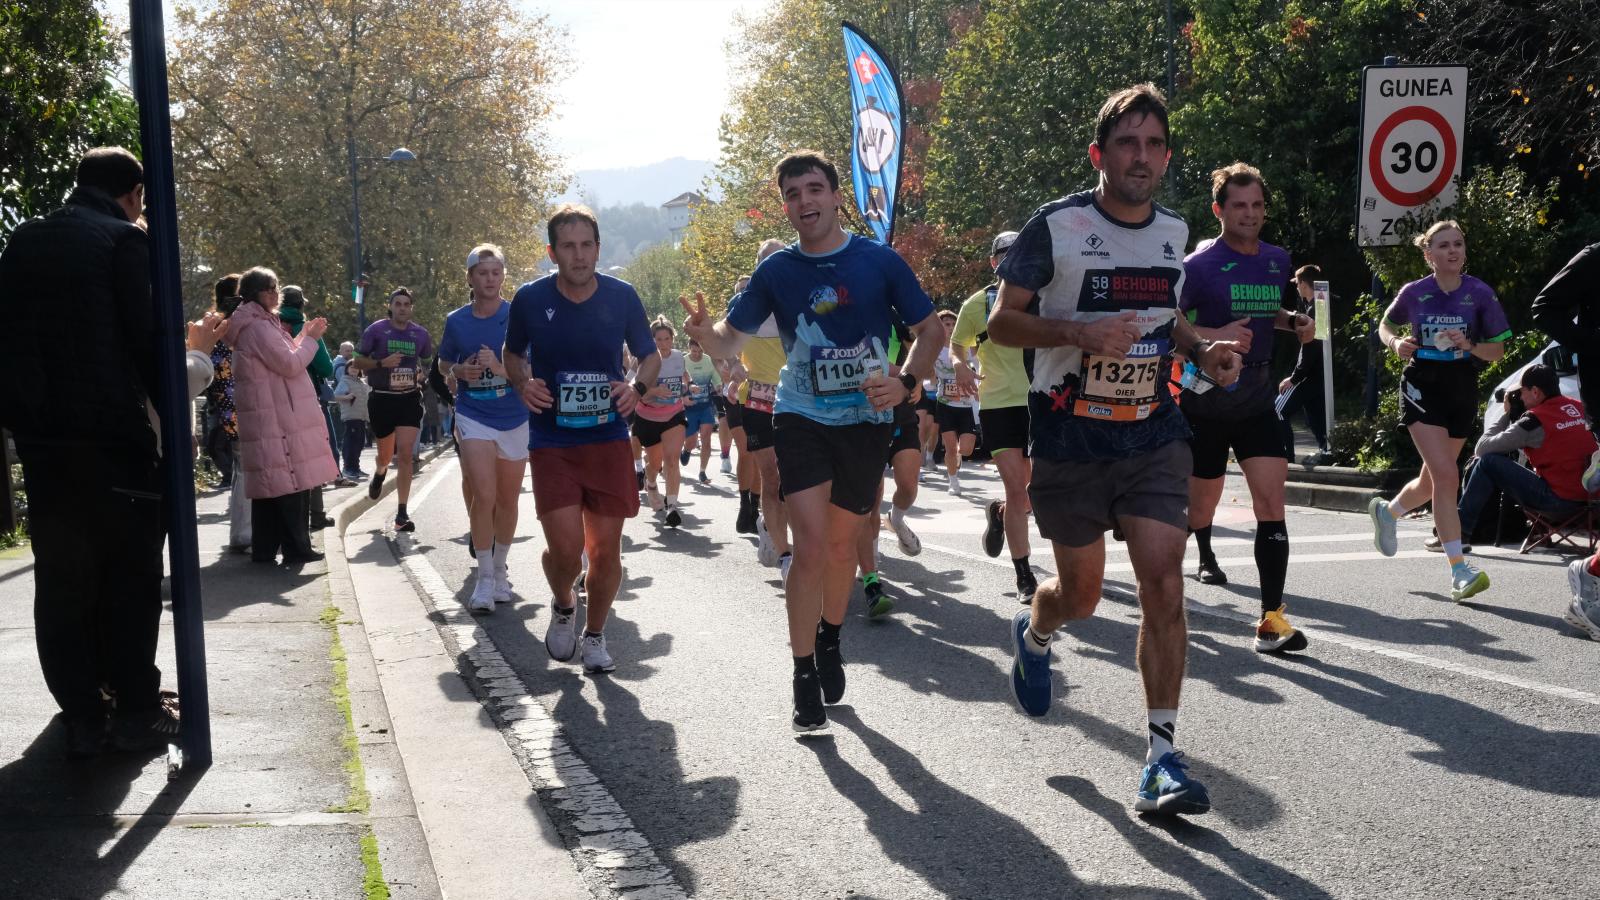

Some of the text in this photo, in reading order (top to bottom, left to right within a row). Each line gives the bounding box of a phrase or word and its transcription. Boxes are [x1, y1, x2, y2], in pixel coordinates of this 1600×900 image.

[1380, 78, 1453, 98] GUNEA
[1390, 141, 1438, 174] 30
[1091, 276, 1169, 291] 58 BEHOBIA
[1231, 284, 1281, 300] BEHOBIA
[1231, 301, 1246, 311] SAN
[818, 353, 872, 380] 1104
[1091, 360, 1158, 384] 13275
[561, 385, 611, 403] 7516
[1115, 389, 1136, 397] OIER
[1088, 404, 1111, 416] Kaiku
